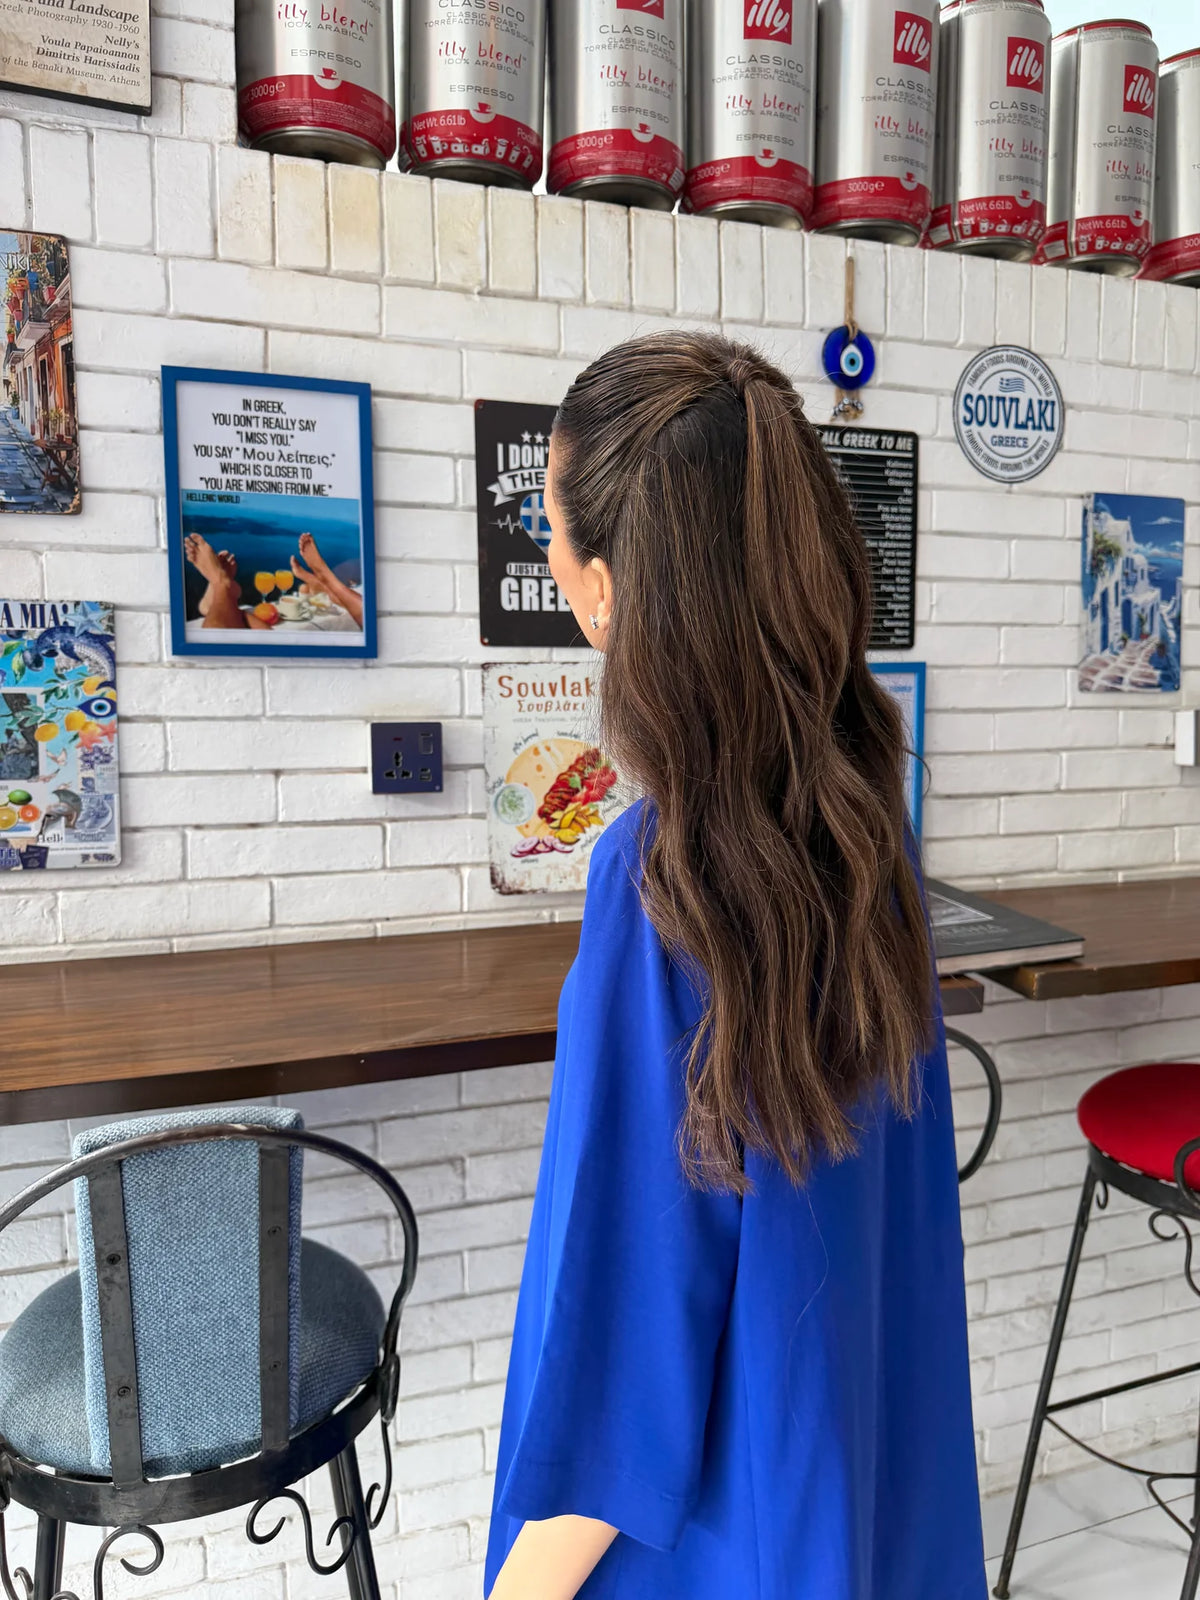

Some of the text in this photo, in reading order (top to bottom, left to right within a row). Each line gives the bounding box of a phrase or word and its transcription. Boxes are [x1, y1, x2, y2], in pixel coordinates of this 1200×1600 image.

[0, 2, 24, 13] reek
[27, 6, 89, 26] Photography
[69, 0, 140, 23] Landscape
[277, 3, 308, 22] illy
[320, 3, 369, 35] blend
[438, 0, 525, 22] CLASSICO
[446, 11, 487, 20] CLASSIC
[746, 0, 790, 36] illy
[104, 34, 140, 50] Nelly's
[317, 23, 366, 42] ARABICA
[599, 24, 676, 51] CLASSICO
[896, 21, 931, 63] illy
[41, 34, 140, 61] Voula Papaioannou
[438, 40, 522, 68] illy blend
[36, 46, 140, 73] Dimitris Harissiadis
[290, 48, 362, 69] ESPRESSO
[474, 59, 519, 76] ARABICA
[726, 54, 804, 73] CLASSICO
[1009, 46, 1043, 85] illy
[14, 57, 29, 67] the
[31, 60, 64, 73] Benaki
[109, 75, 141, 87] Athens
[600, 64, 675, 92] illy blend
[449, 84, 515, 102] ESPRESSO
[635, 83, 673, 101] ARABICA
[1126, 73, 1154, 111] illy
[726, 92, 801, 116] illy blend
[611, 106, 671, 124] ESPRESSO
[874, 115, 900, 133] illy
[413, 121, 426, 131] Net
[736, 133, 795, 146] ESPRESSO
[989, 138, 1014, 153] illy
[1106, 160, 1130, 176] illy
[242, 399, 287, 415] IN GREEK,
[962, 393, 1056, 432] SOUVLAKI
[212, 413, 317, 433] YOU DON'T REALLY SAY
[245, 431, 268, 446] MISS
[822, 431, 914, 451] ALL GREEK TO ME
[990, 434, 1029, 449] GREECE
[193, 444, 213, 458] YOU
[214, 446, 233, 459] SAY
[497, 443, 549, 473] I DON'
[220, 462, 313, 480] WHICH IS CLOSER TO
[225, 479, 243, 491] ARE
[246, 480, 283, 494] MISSING
[285, 483, 311, 496] FROM
[186, 492, 241, 505] HELLENIC WORLD
[508, 564, 513, 575] I
[514, 564, 535, 575] JUST
[20, 602, 69, 628] MIA!
[516, 700, 586, 714] Σουβλάκι
